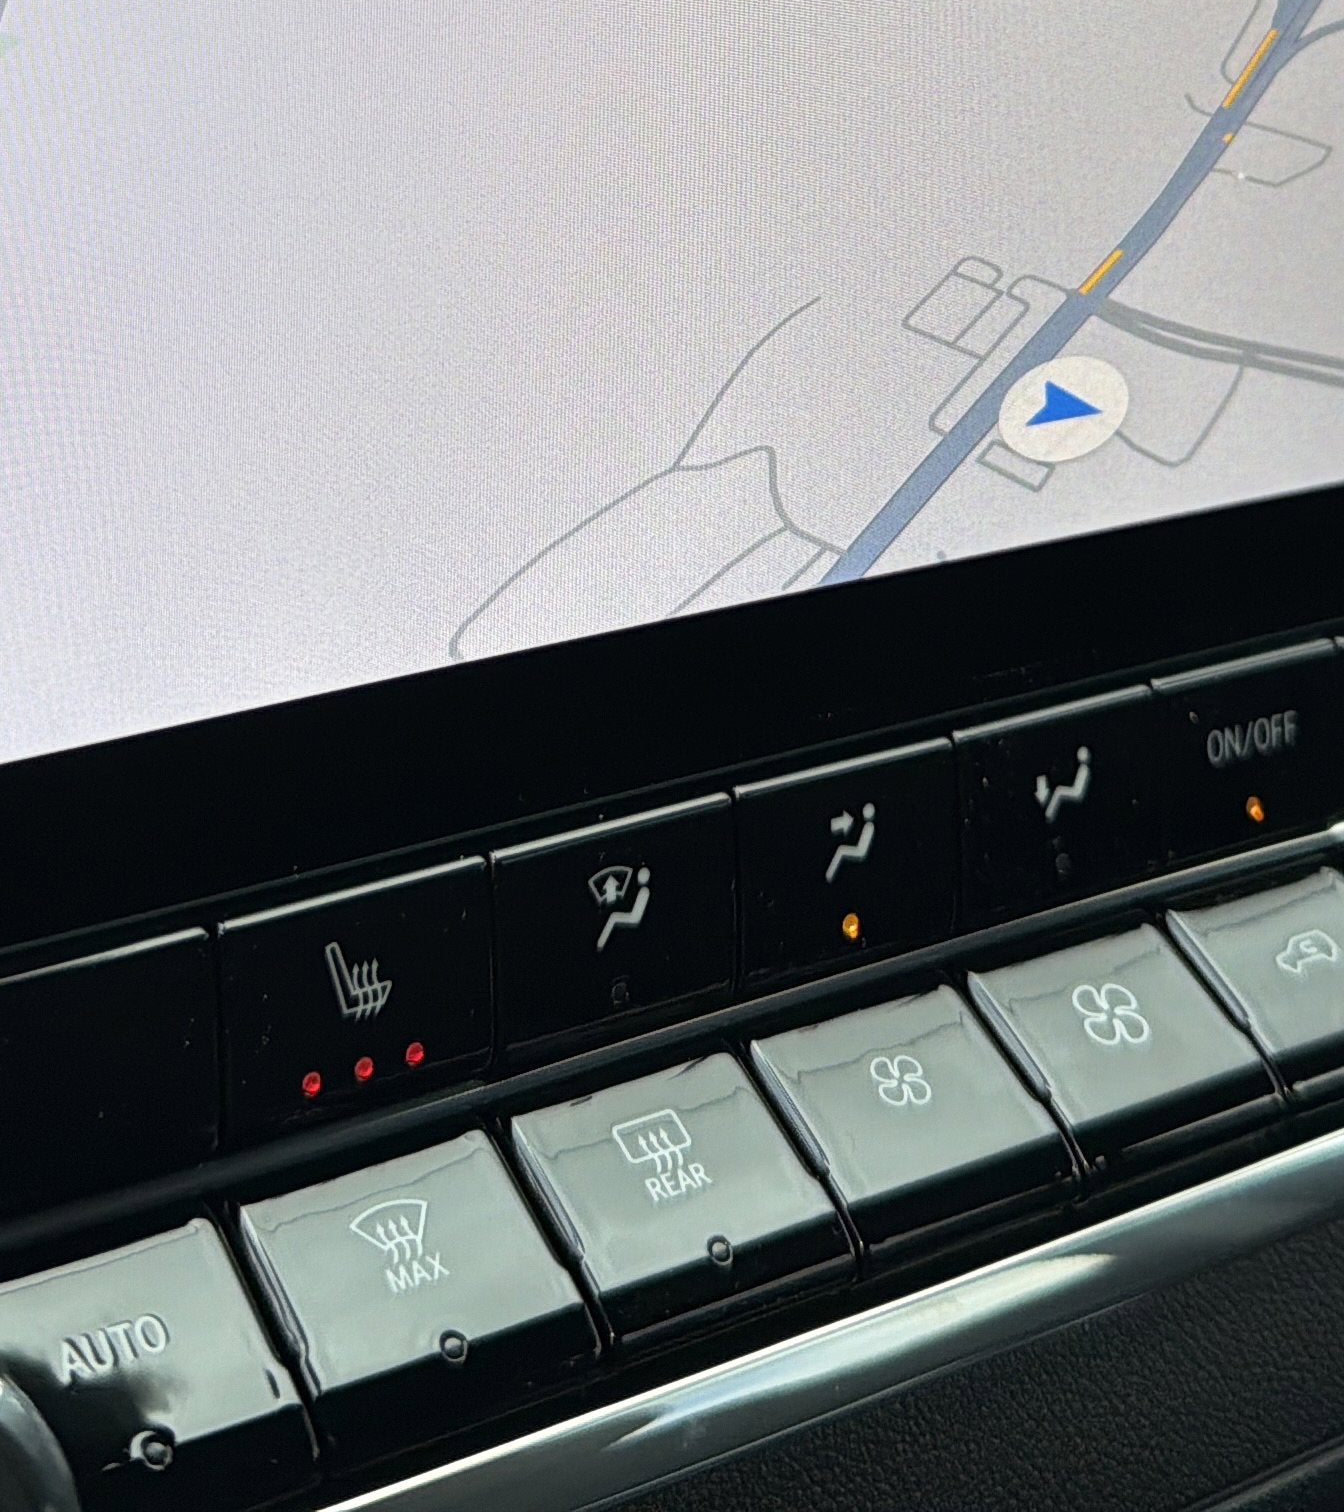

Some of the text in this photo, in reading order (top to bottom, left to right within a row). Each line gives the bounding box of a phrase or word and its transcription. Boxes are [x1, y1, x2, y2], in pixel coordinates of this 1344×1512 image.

[1206, 709, 1299, 768] ON/OFF
[644, 1162, 714, 1205] REAR
[385, 1251, 451, 1295] MAX
[58, 1313, 169, 1385] AUTO
